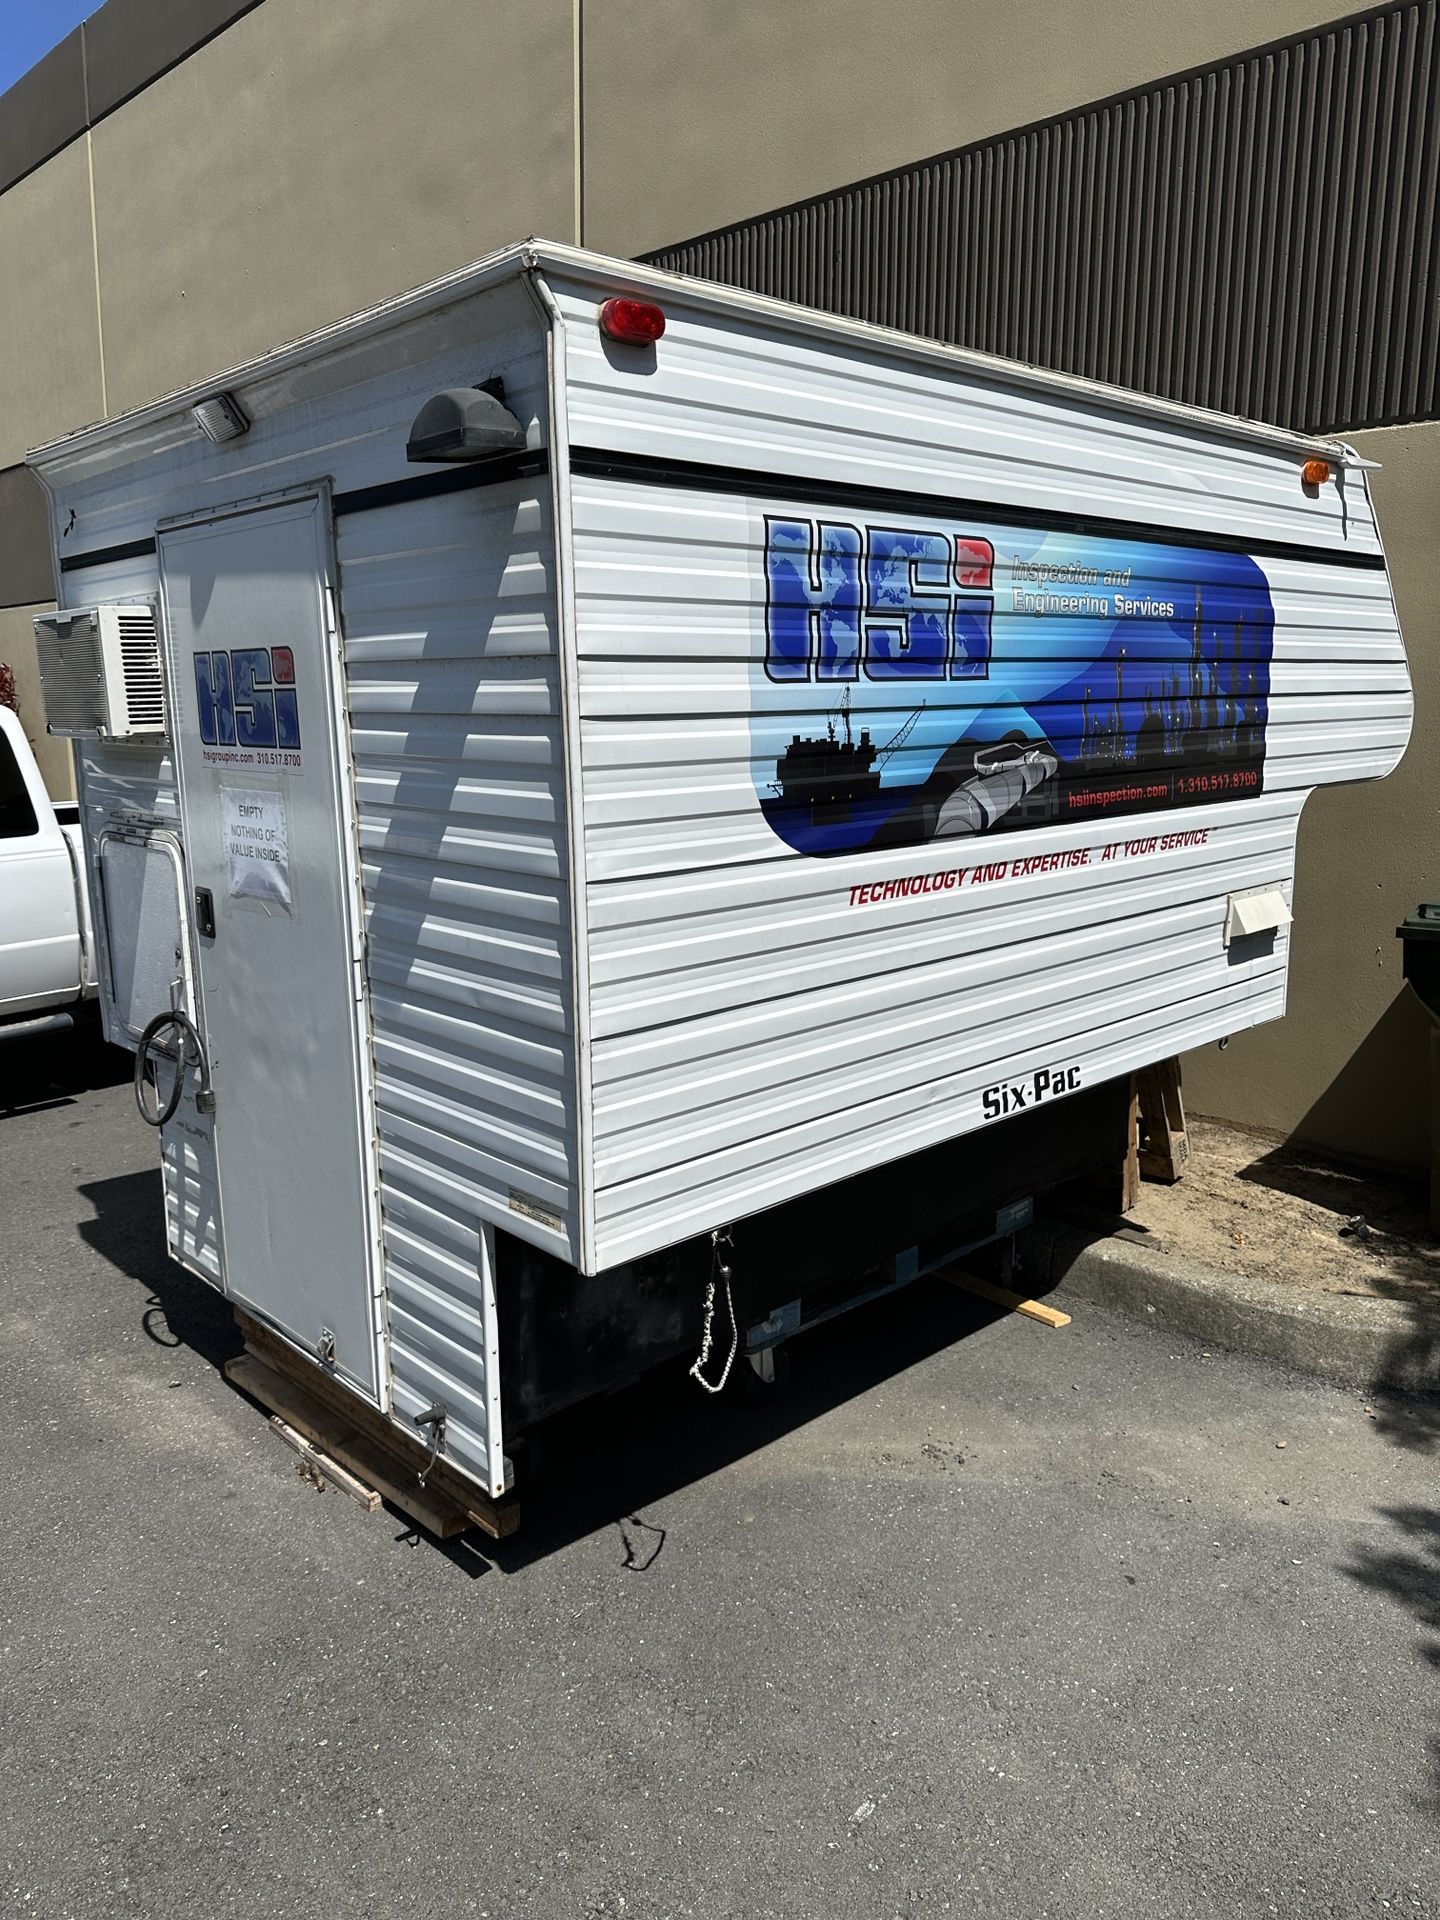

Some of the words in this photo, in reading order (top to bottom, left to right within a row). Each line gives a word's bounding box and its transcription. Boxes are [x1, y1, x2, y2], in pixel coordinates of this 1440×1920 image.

[1011, 555, 1098, 588] Inspection
[1103, 566, 1132, 588] and
[1011, 586, 1109, 620] Engineering
[1113, 593, 1174, 618] Services
[203, 749, 254, 765] hsigroupinc.com
[257, 752, 301, 767] 310.517.8700
[1069, 784, 1168, 808] hsiinspection.com
[1178, 771, 1257, 794] 1.310.517.8700
[239, 804, 263, 819] EMPTY
[231, 824, 264, 841] NOTHING
[265, 828, 276, 842] OF
[230, 842, 254, 858] VALUE
[255, 846, 281, 863] INSIDE
[849, 867, 970, 906] TECHNOLOGY
[971, 861, 1008, 885] AND
[1011, 847, 1092, 877] EXPERTISE.
[1101, 842, 1120, 861] AT
[1124, 836, 1158, 857] YOUR
[1160, 827, 1210, 851] SERVICE
